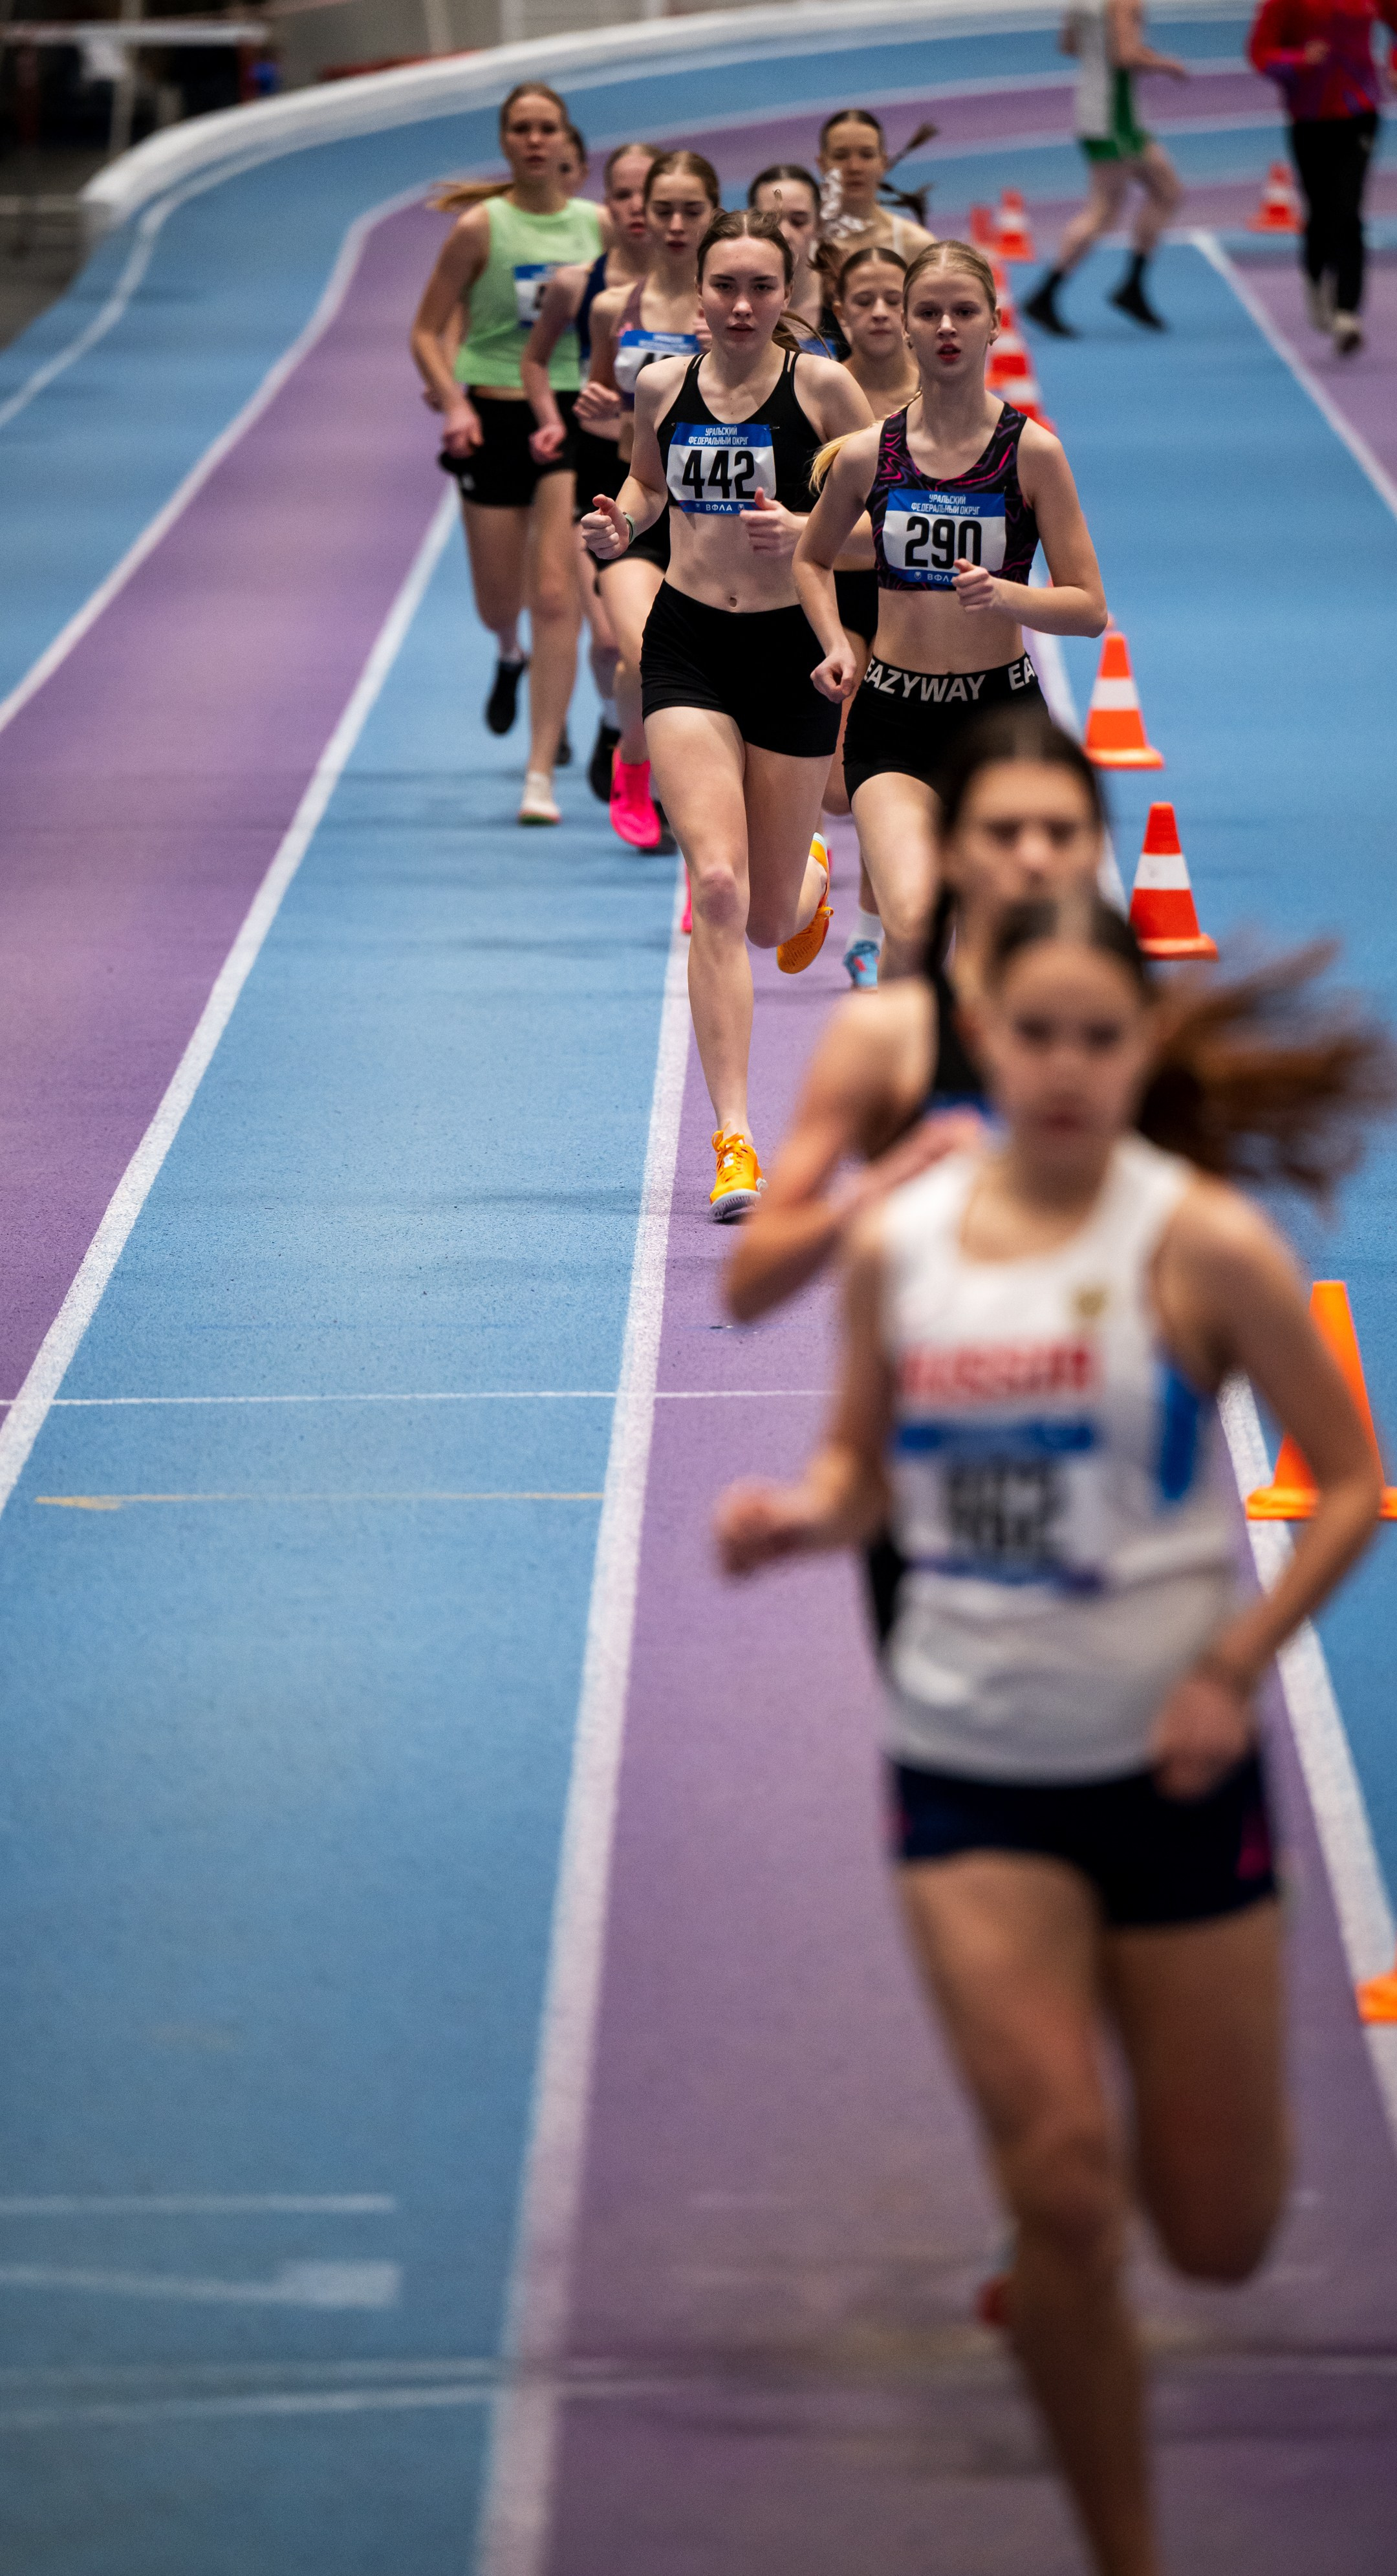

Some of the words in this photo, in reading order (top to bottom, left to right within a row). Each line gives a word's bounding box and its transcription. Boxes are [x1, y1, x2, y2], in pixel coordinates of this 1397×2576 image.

[705, 426, 737, 437] УРАЛЬСКИЙ
[688, 435, 731, 446] ФЕДЕРАЛЬНЫЙ
[732, 436, 749, 445] ОКРУГ
[682, 449, 755, 499] 442
[929, 494, 966, 504] УРАЛЬСКИЙ
[911, 503, 959, 515] ФЕДЕРАЛЬНЫЙ
[960, 505, 980, 515] ОКРУГ
[905, 515, 982, 570] 290
[927, 573, 953, 583] ВФЛ
